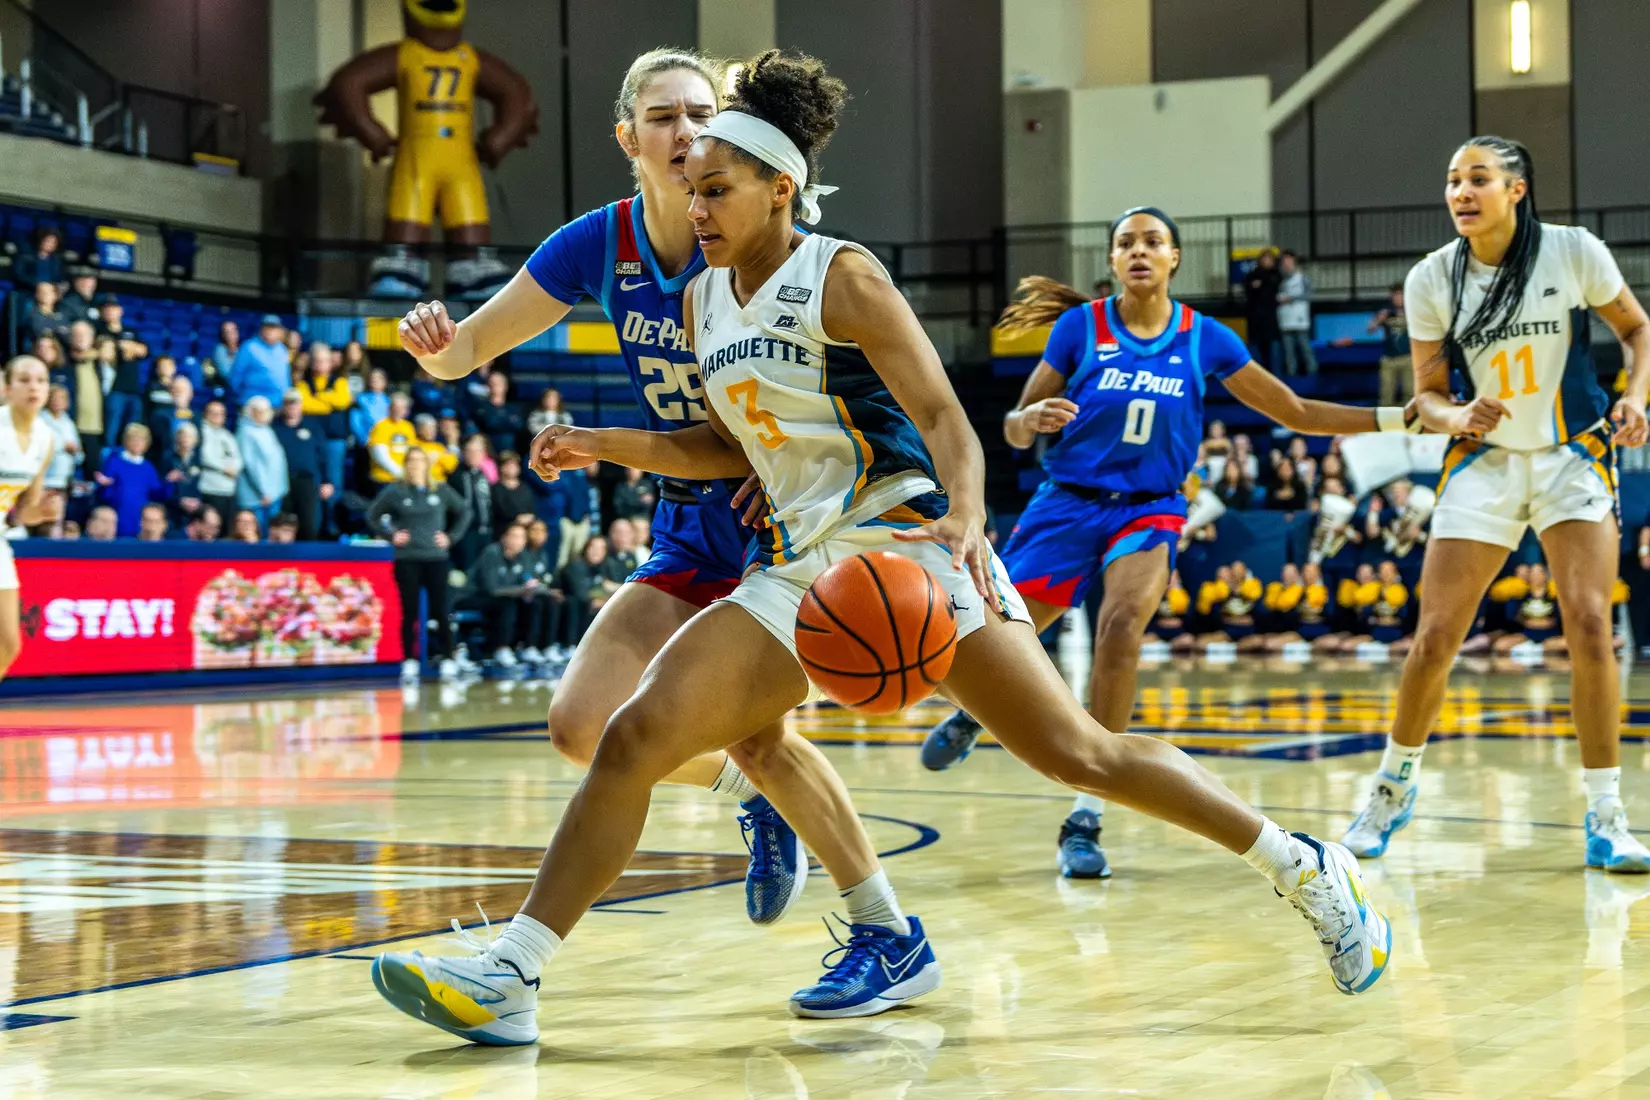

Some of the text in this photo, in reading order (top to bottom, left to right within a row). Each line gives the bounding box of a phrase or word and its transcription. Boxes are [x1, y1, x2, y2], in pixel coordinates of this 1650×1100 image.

[424, 66, 461, 97] 77
[622, 310, 694, 352] DEPA
[638, 356, 709, 421] 25
[1489, 344, 1540, 400] 11
[725, 377, 790, 449] 3
[1122, 398, 1157, 446] 0
[44, 598, 174, 641] STAY!
